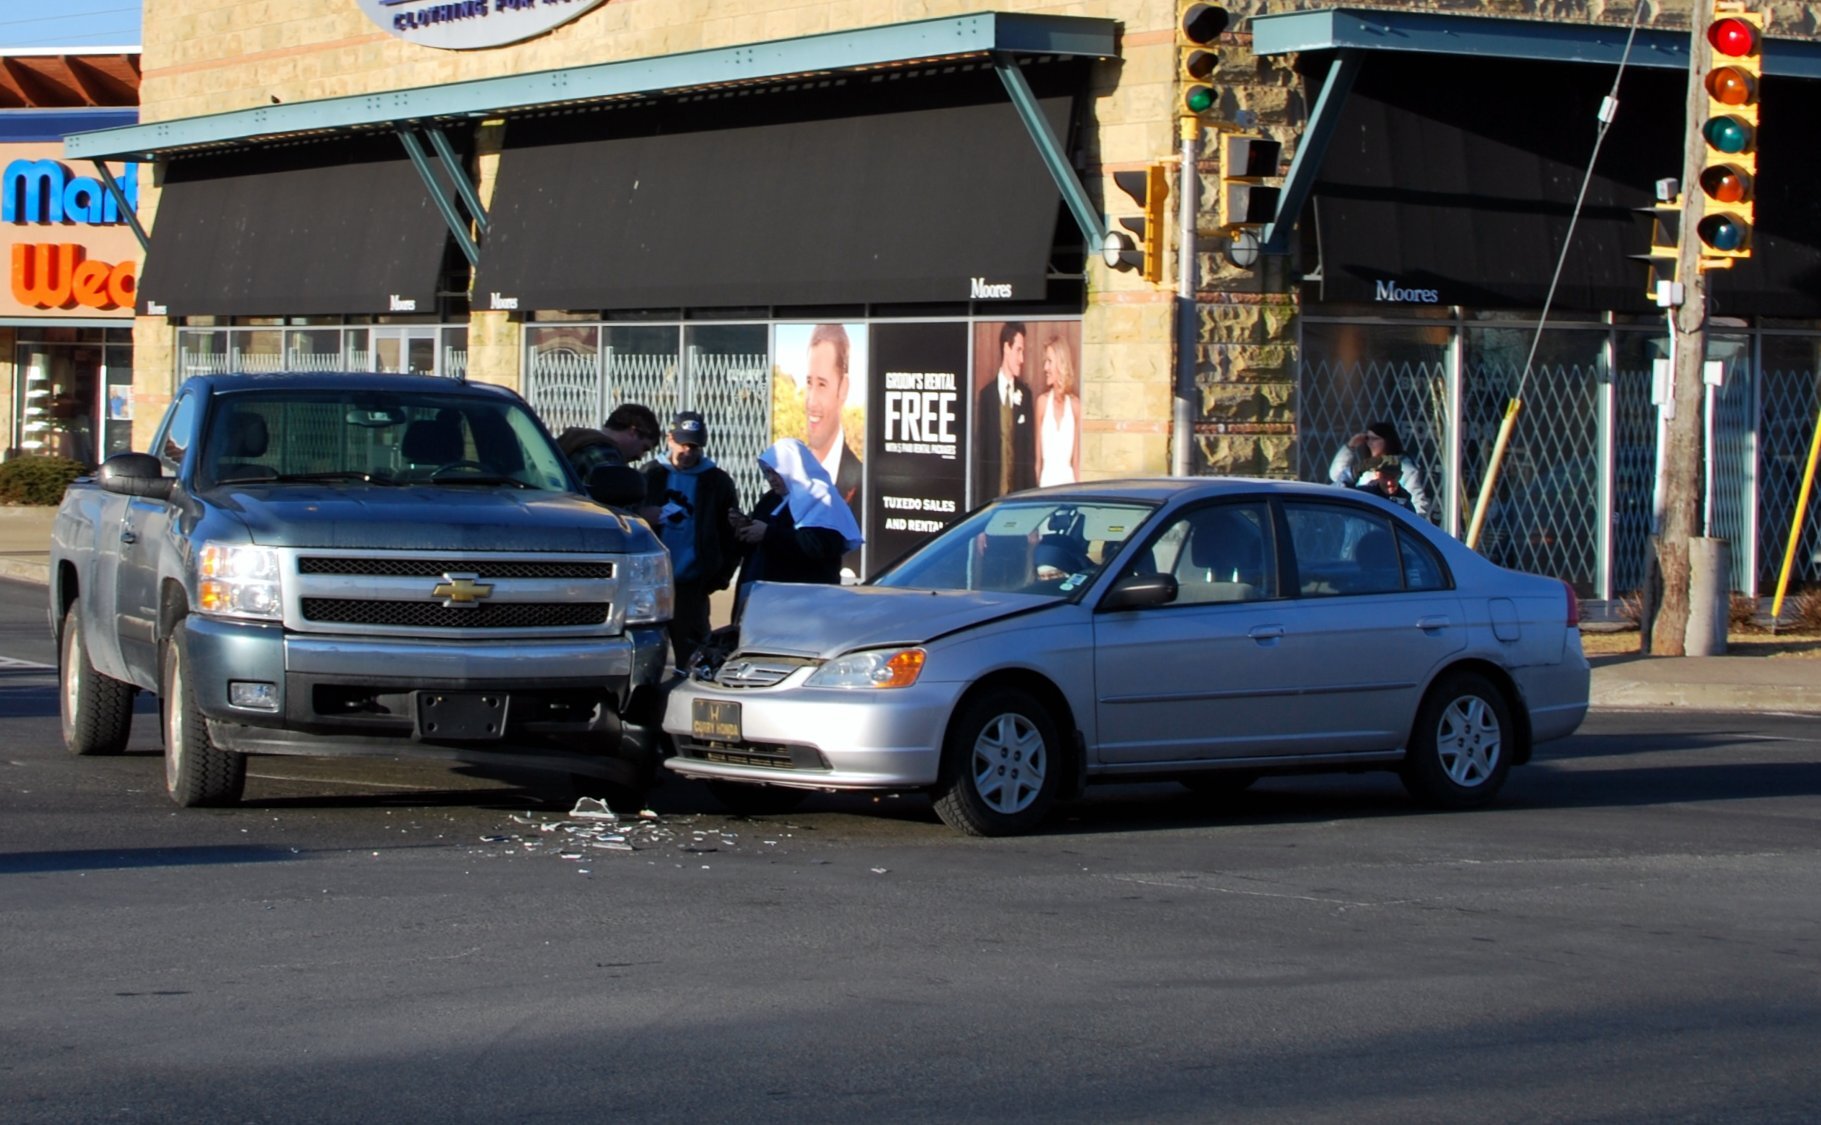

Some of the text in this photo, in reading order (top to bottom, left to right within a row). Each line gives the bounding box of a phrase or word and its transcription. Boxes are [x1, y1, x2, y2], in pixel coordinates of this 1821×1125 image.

[394, 0, 488, 30] CLOTHING
[970, 277, 1012, 298] Moores
[1376, 279, 1439, 302] Moores
[924, 373, 957, 391] RENTAL
[884, 391, 957, 443] FREE
[882, 496, 956, 512] TUXEDO SALES
[885, 518, 907, 530] AND
